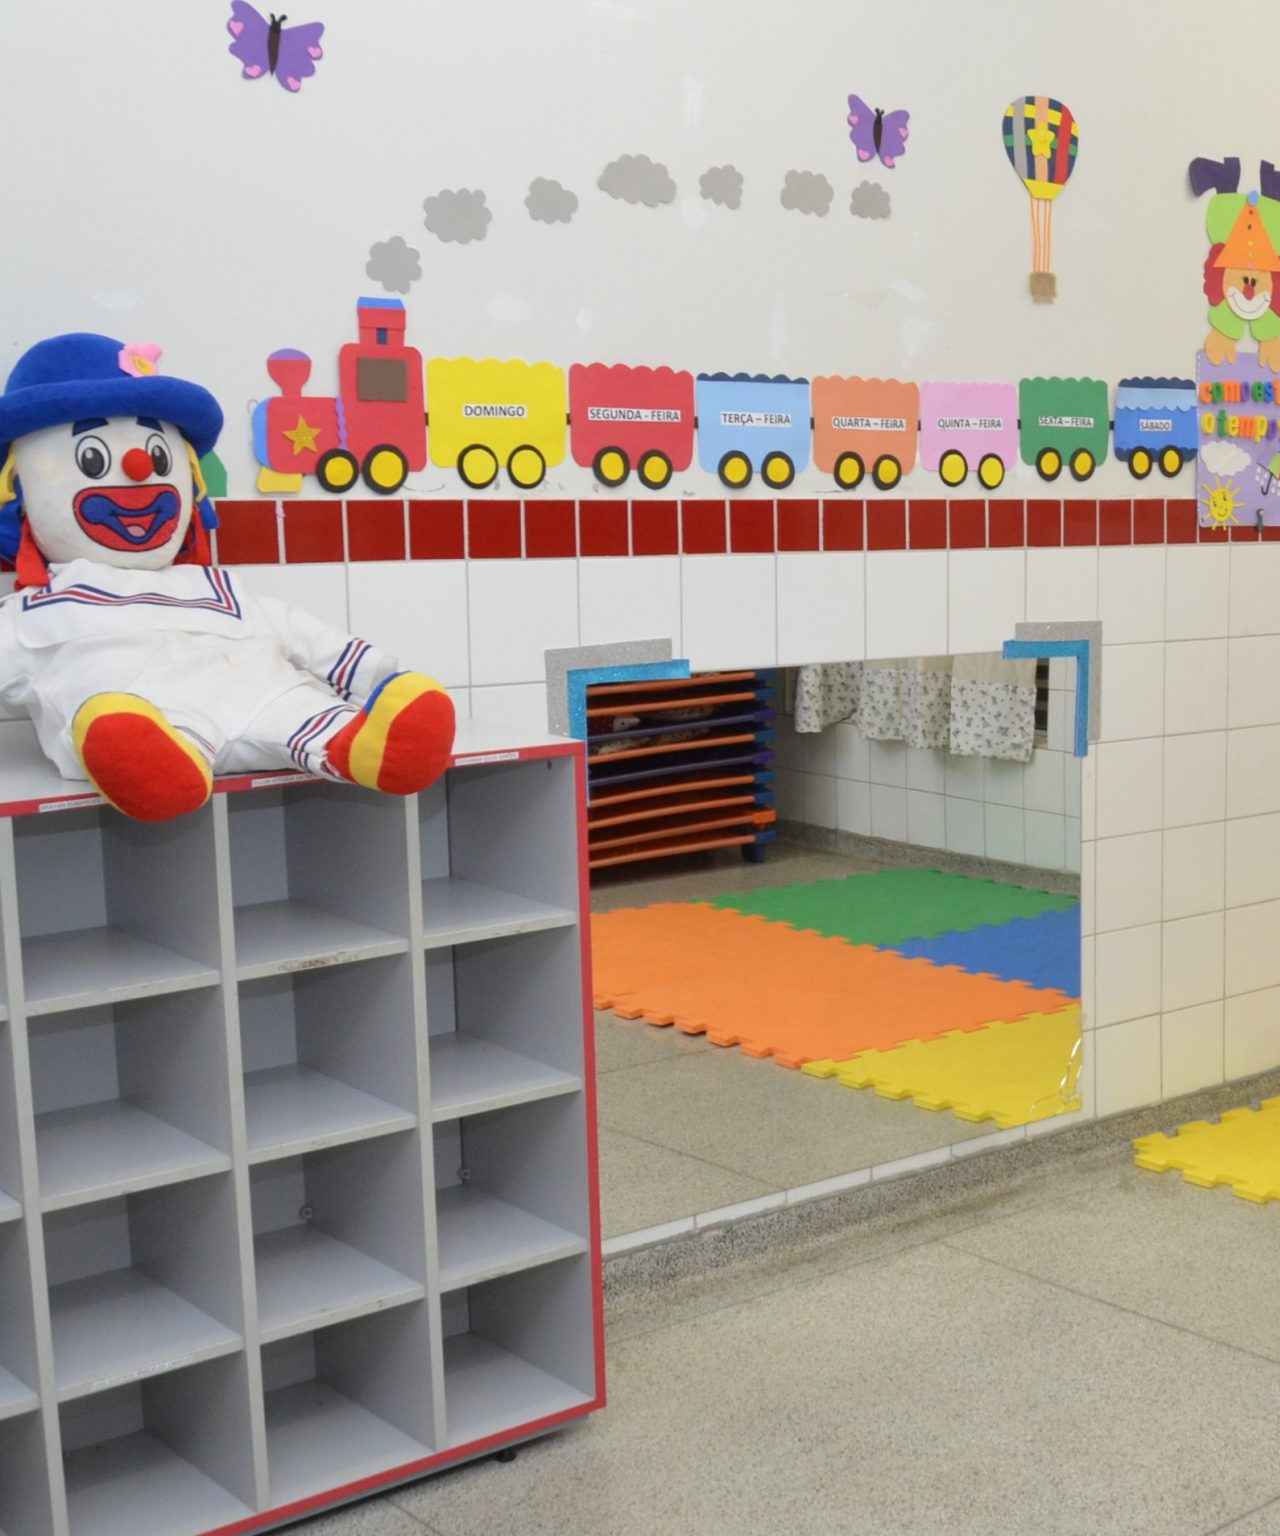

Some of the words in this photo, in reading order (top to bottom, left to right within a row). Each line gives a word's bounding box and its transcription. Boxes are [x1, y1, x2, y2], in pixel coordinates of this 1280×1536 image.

[1200, 380, 1250, 404] como
[464, 405, 525, 417] DOMINGO
[589, 408, 642, 420] SEGUNDA
[650, 410, 679, 421] FEIRA
[722, 413, 754, 426] TERÇA
[763, 413, 791, 424] FEIRA
[833, 417, 871, 428] QUARTA
[880, 418, 904, 429] FEIRA
[937, 418, 971, 430] QUINTA
[979, 419, 1002, 429] FEIRA
[1039, 415, 1063, 425] SEXTA
[1071, 416, 1092, 426] FEIRA
[1202, 412, 1215, 435] o
